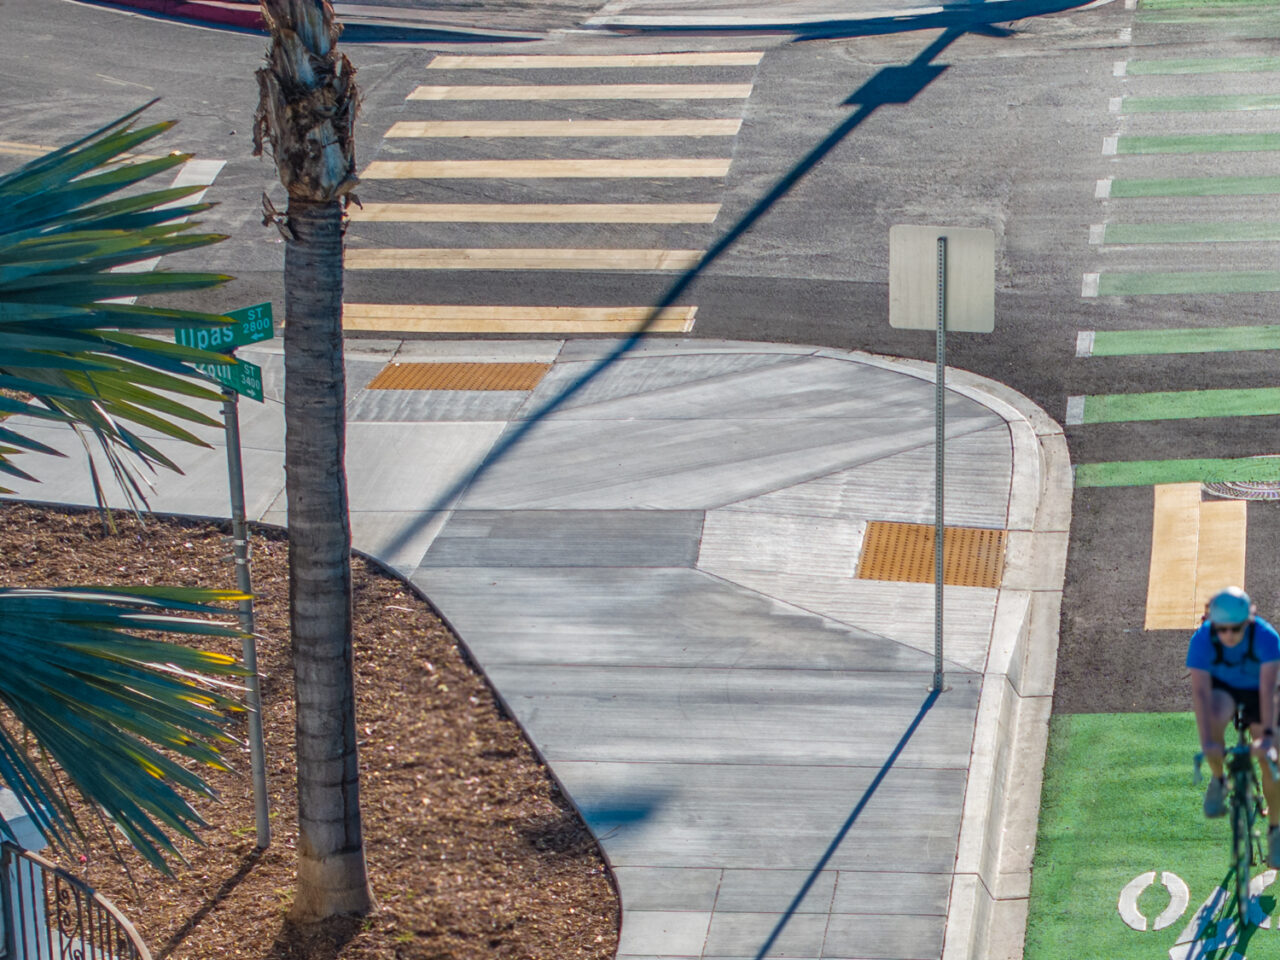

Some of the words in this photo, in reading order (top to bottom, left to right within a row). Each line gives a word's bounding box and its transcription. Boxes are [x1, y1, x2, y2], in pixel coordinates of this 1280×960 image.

[247, 307, 263, 320] ST
[242, 318, 270, 334] 2800
[243, 364, 255, 377] ST
